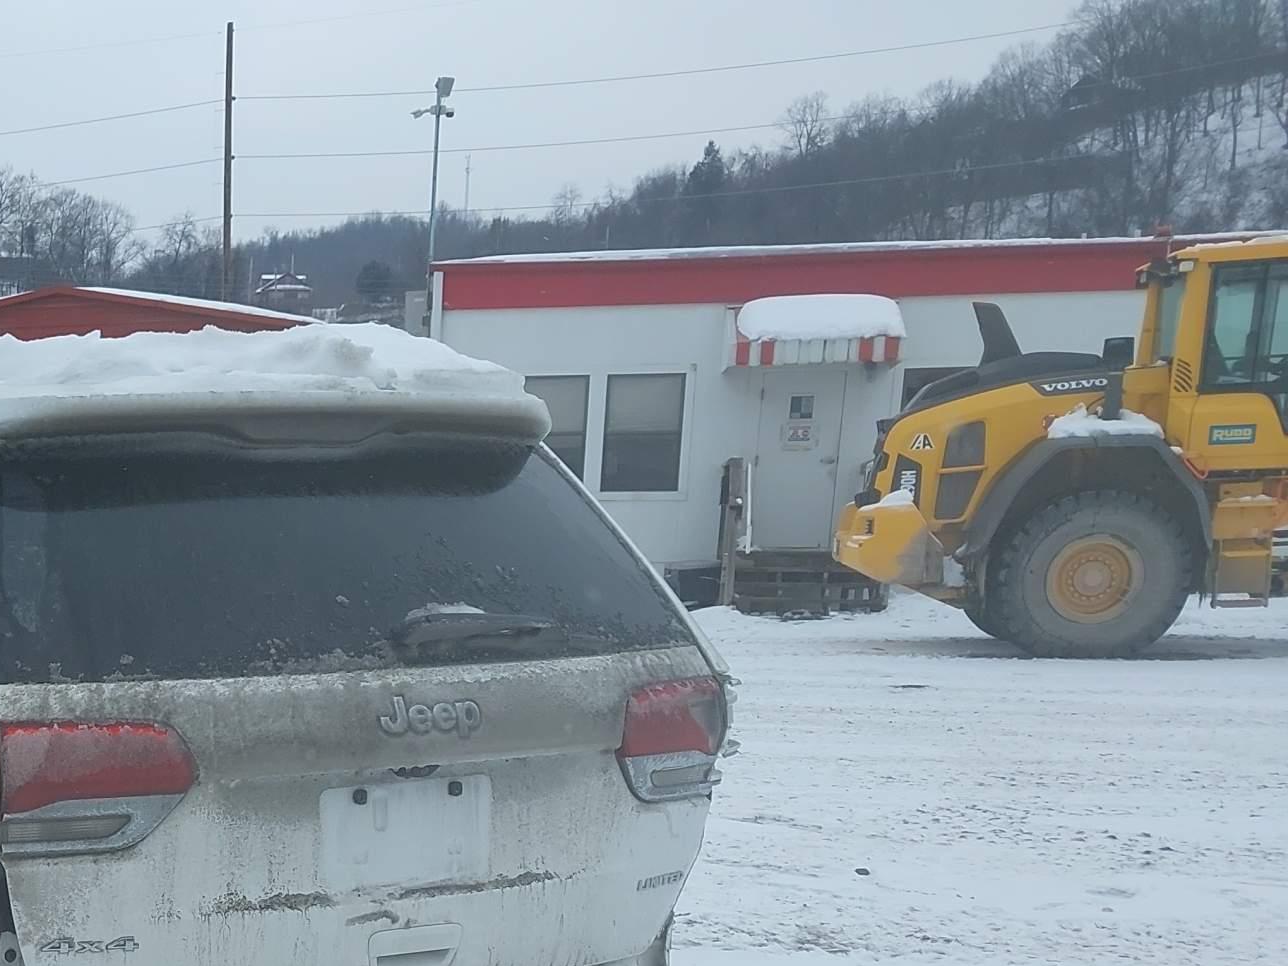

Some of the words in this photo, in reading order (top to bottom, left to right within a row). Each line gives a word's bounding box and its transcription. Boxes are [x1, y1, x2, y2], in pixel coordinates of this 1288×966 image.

[1040, 378, 1108, 391] VOLVO
[379, 695, 482, 739] Jeep
[40, 935, 140, 954] 4x4
